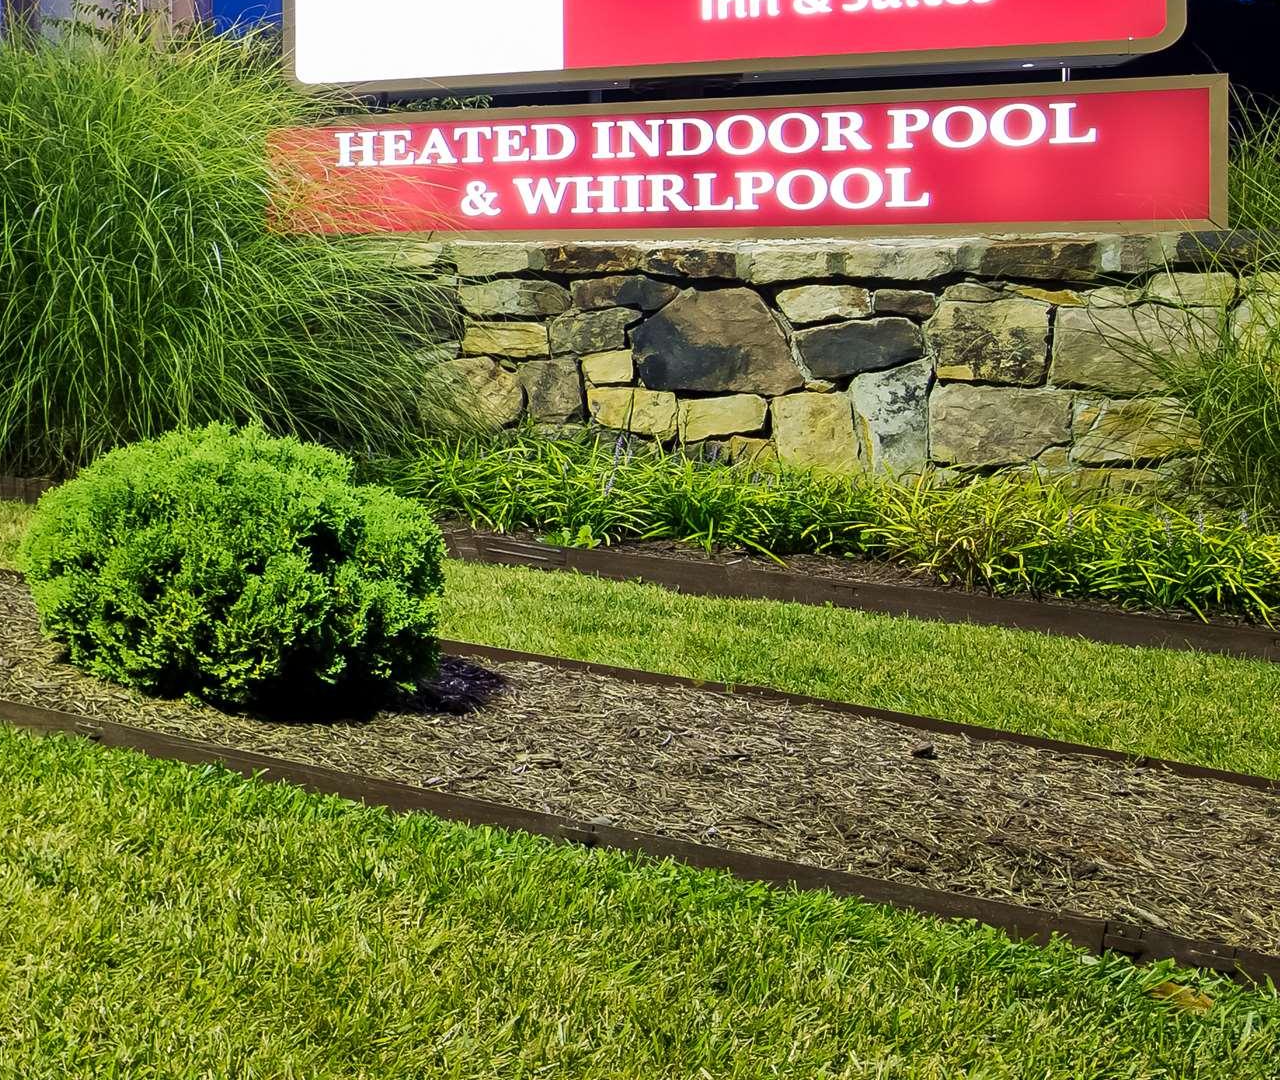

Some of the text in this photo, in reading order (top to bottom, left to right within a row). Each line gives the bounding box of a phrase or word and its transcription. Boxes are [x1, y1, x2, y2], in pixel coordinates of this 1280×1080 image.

[335, 102, 1097, 168] HEATED INDOOR POOL
[460, 167, 930, 217] & WHIRLPOOL
